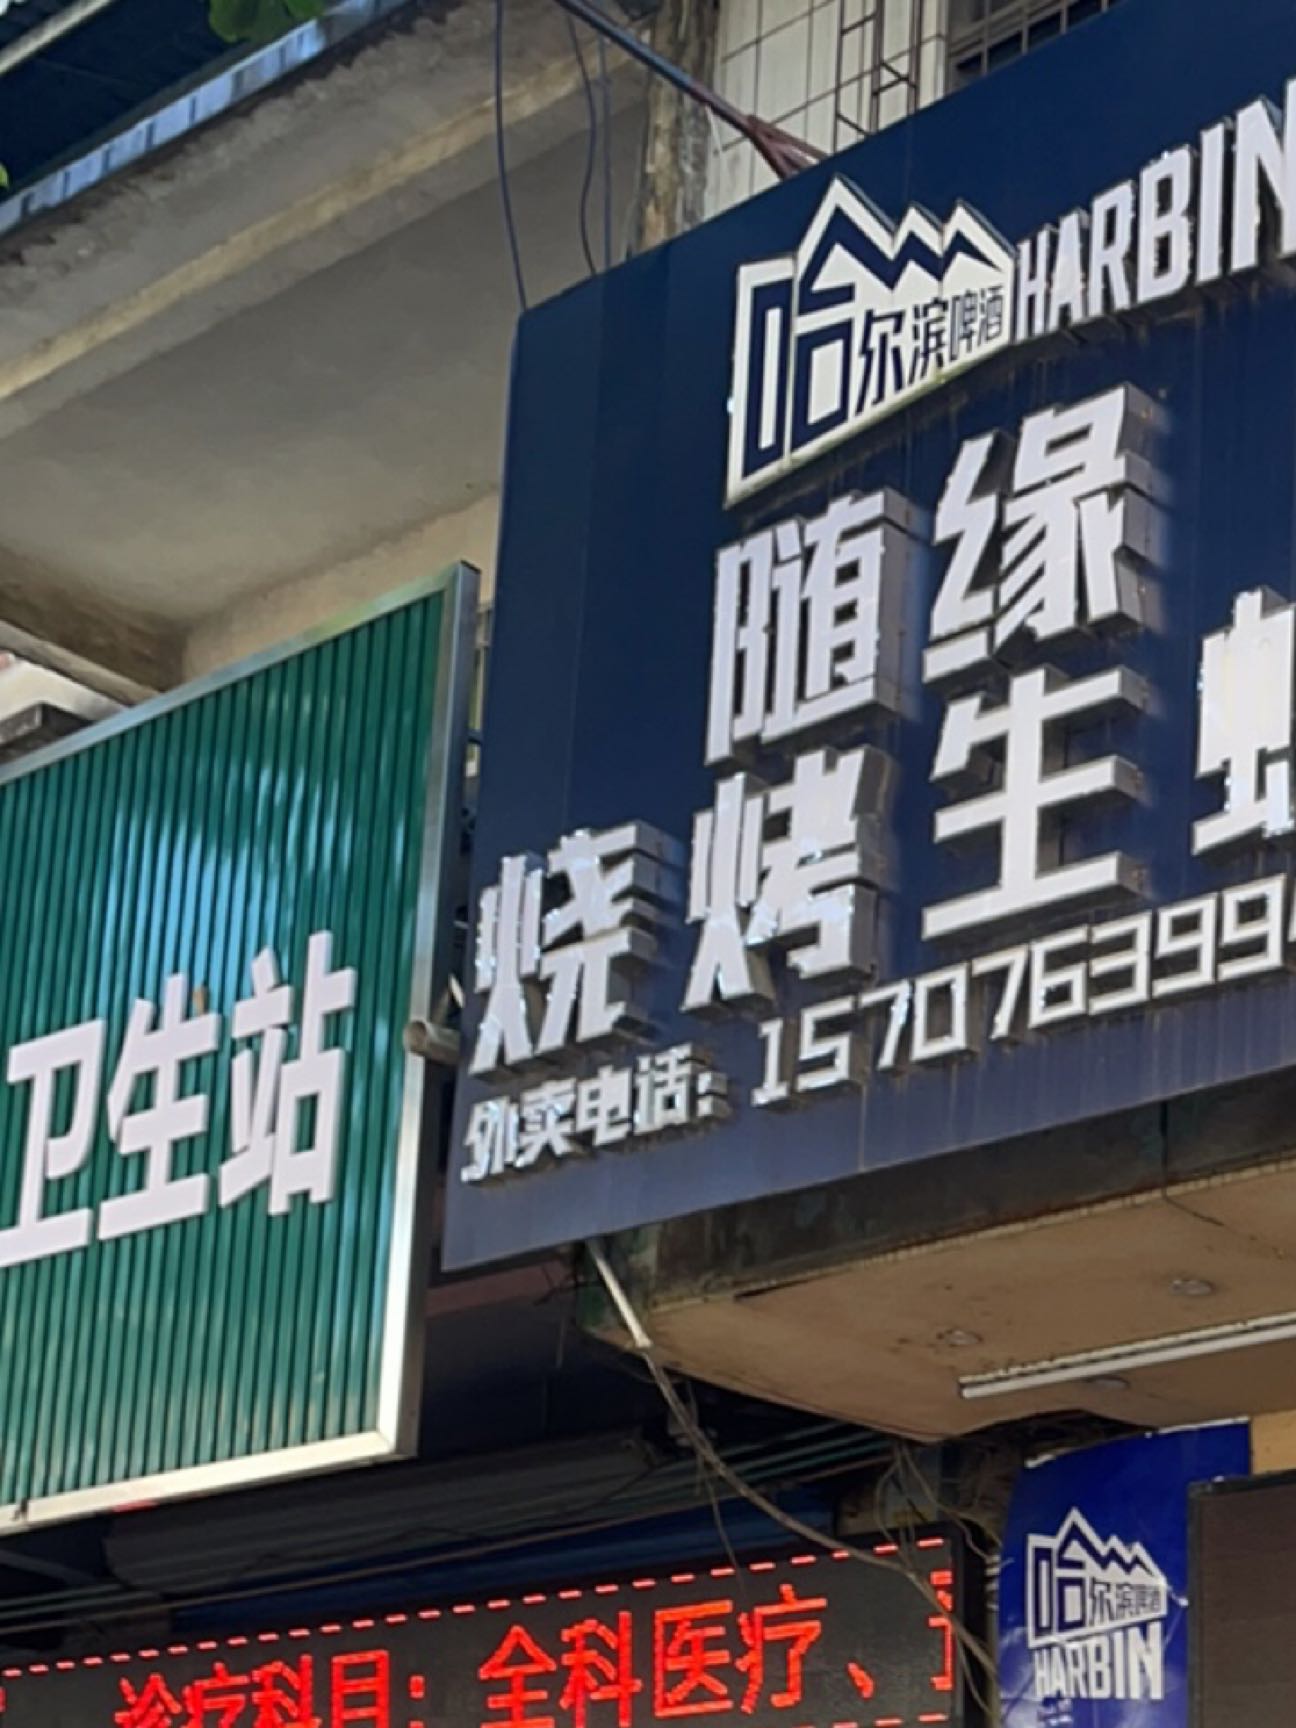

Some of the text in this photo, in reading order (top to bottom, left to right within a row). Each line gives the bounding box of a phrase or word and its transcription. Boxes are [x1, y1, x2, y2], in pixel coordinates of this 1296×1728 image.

[735, 183, 1009, 492] 哈尔滨啤酒
[705, 383, 1135, 766] 随缘
[0, 930, 356, 1267] 卫生站
[1033, 1621, 1164, 1700] HARBIN
